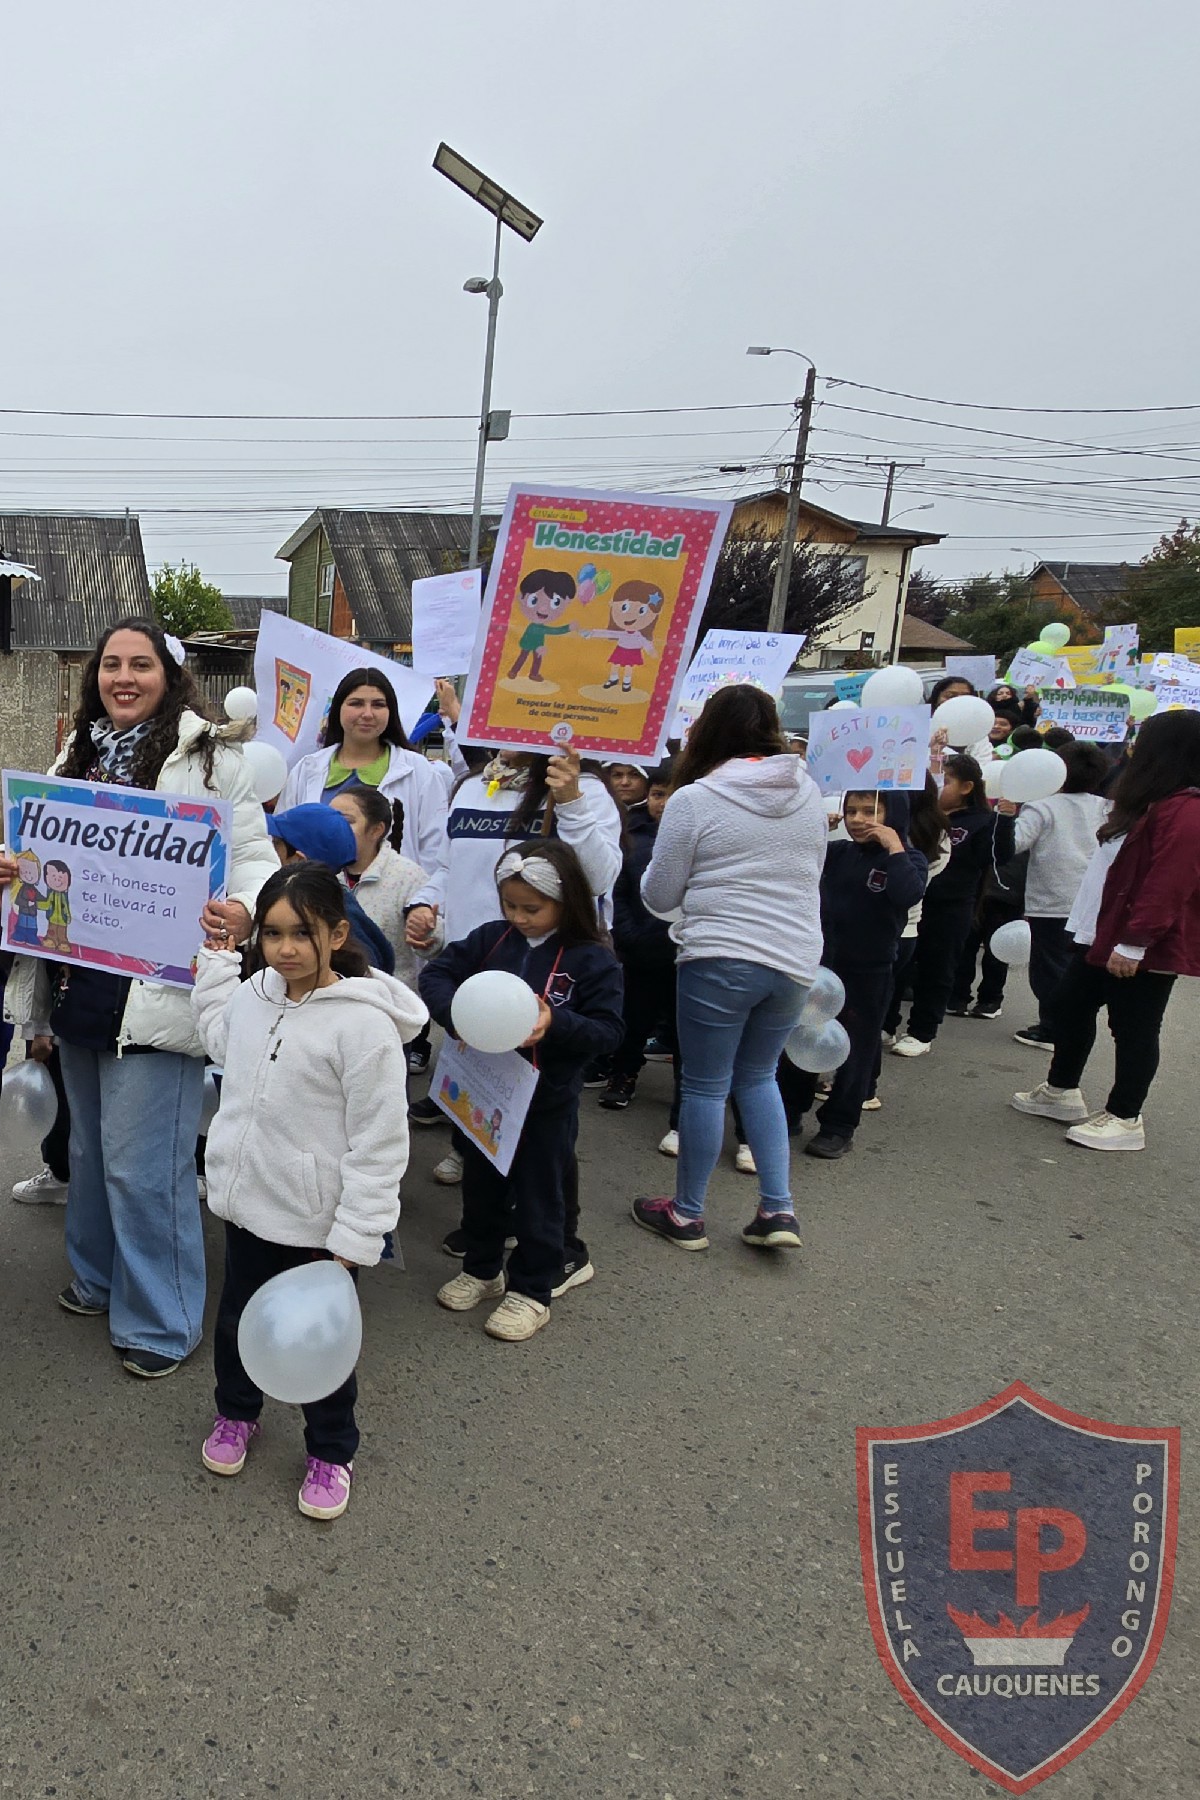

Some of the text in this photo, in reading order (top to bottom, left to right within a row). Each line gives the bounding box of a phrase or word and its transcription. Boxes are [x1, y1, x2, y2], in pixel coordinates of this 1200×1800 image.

[535, 523, 684, 558] Honestidad
[1042, 708, 1125, 723] Es la base del
[17, 802, 218, 867] Honestidad
[81, 868, 176, 896] Ser honesto
[81, 890, 177, 919] te llevará al
[81, 911, 124, 930] éxito.
